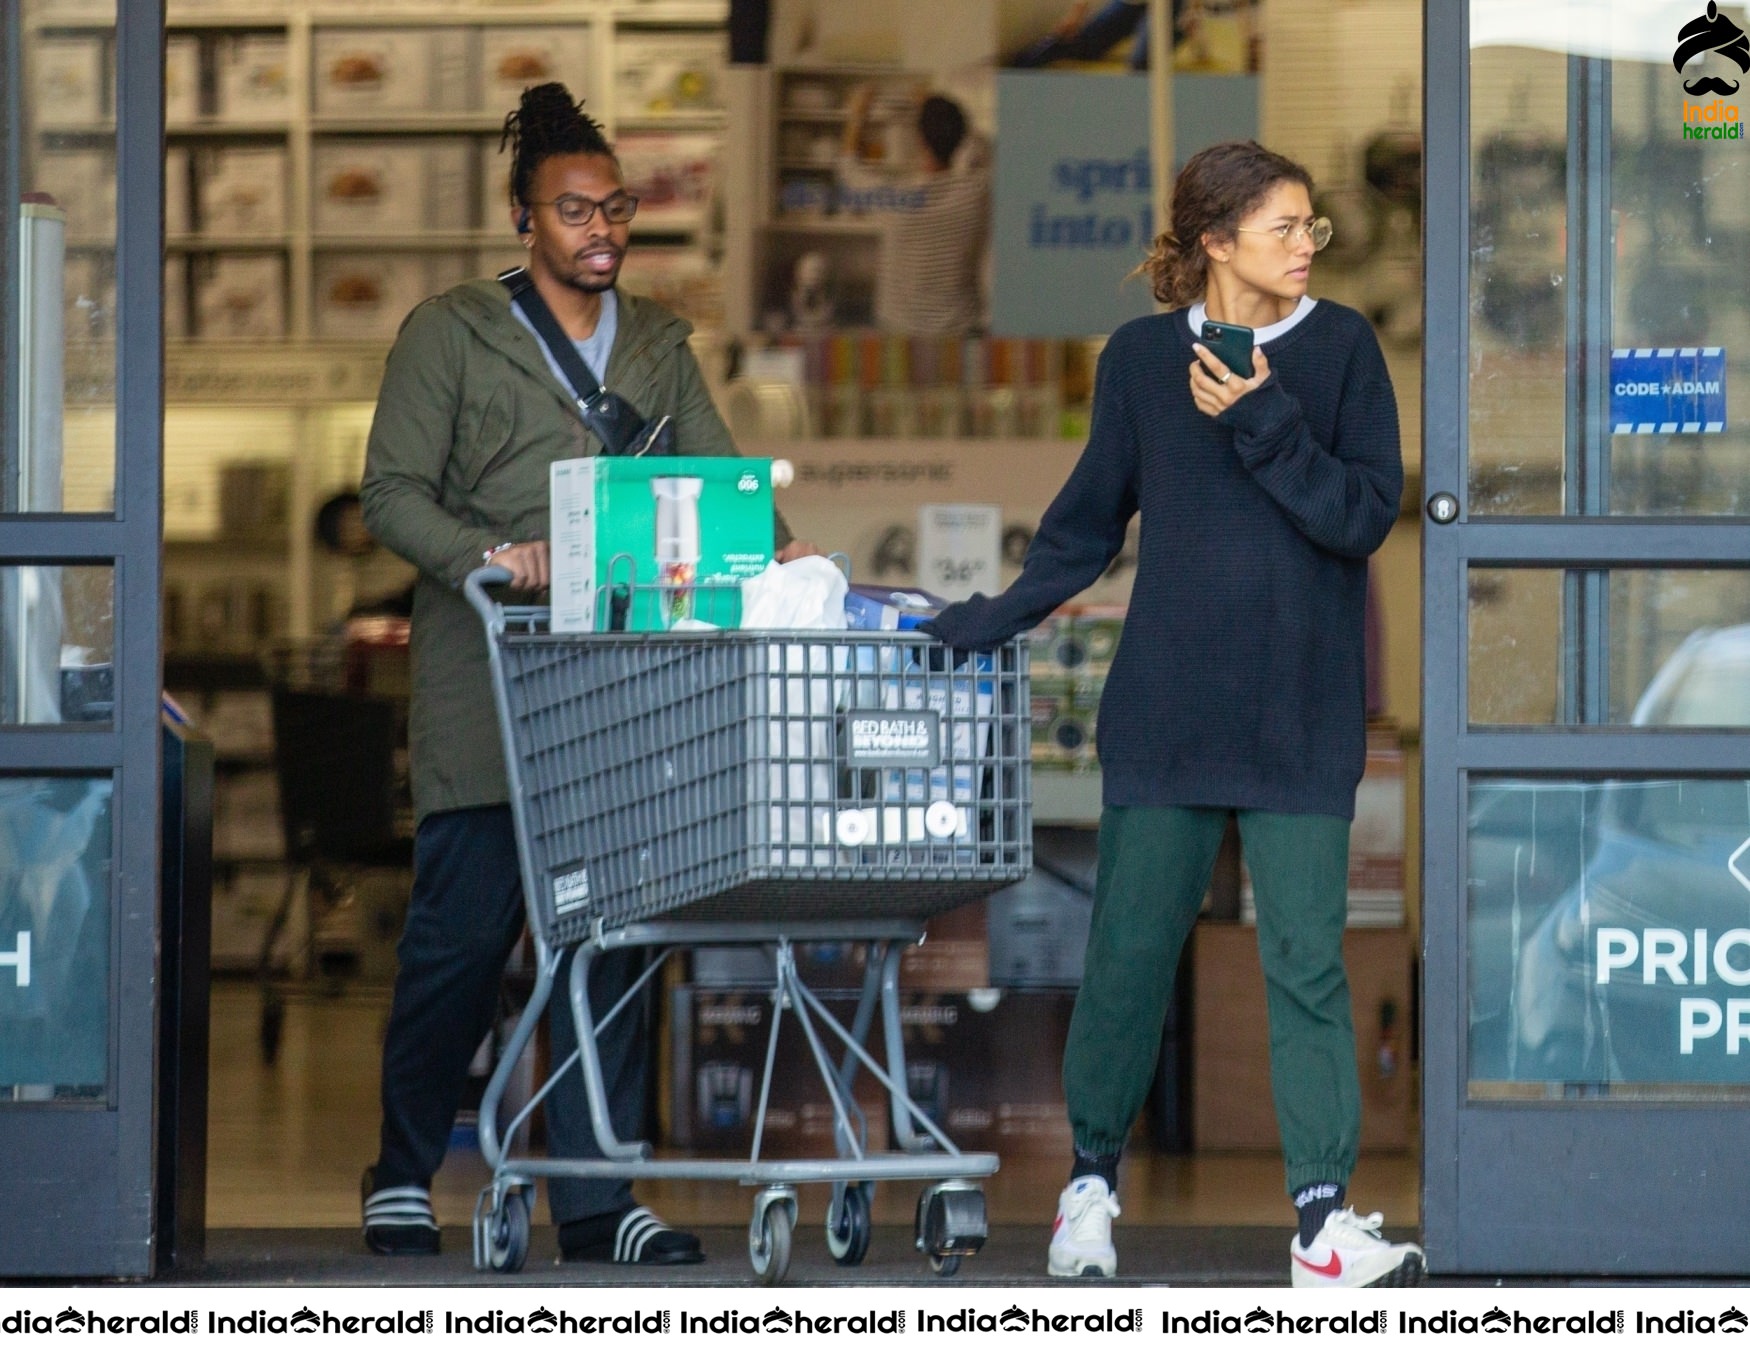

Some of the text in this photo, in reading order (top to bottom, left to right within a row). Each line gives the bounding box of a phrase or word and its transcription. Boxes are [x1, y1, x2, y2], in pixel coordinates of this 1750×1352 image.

[1052, 150, 1152, 201] spri
[1028, 191, 1134, 248] into
[1614, 381, 1720, 396] CODE ADAM
[852, 719, 928, 735] BED BATH &
[1294, 1183, 1339, 1209] ANS
